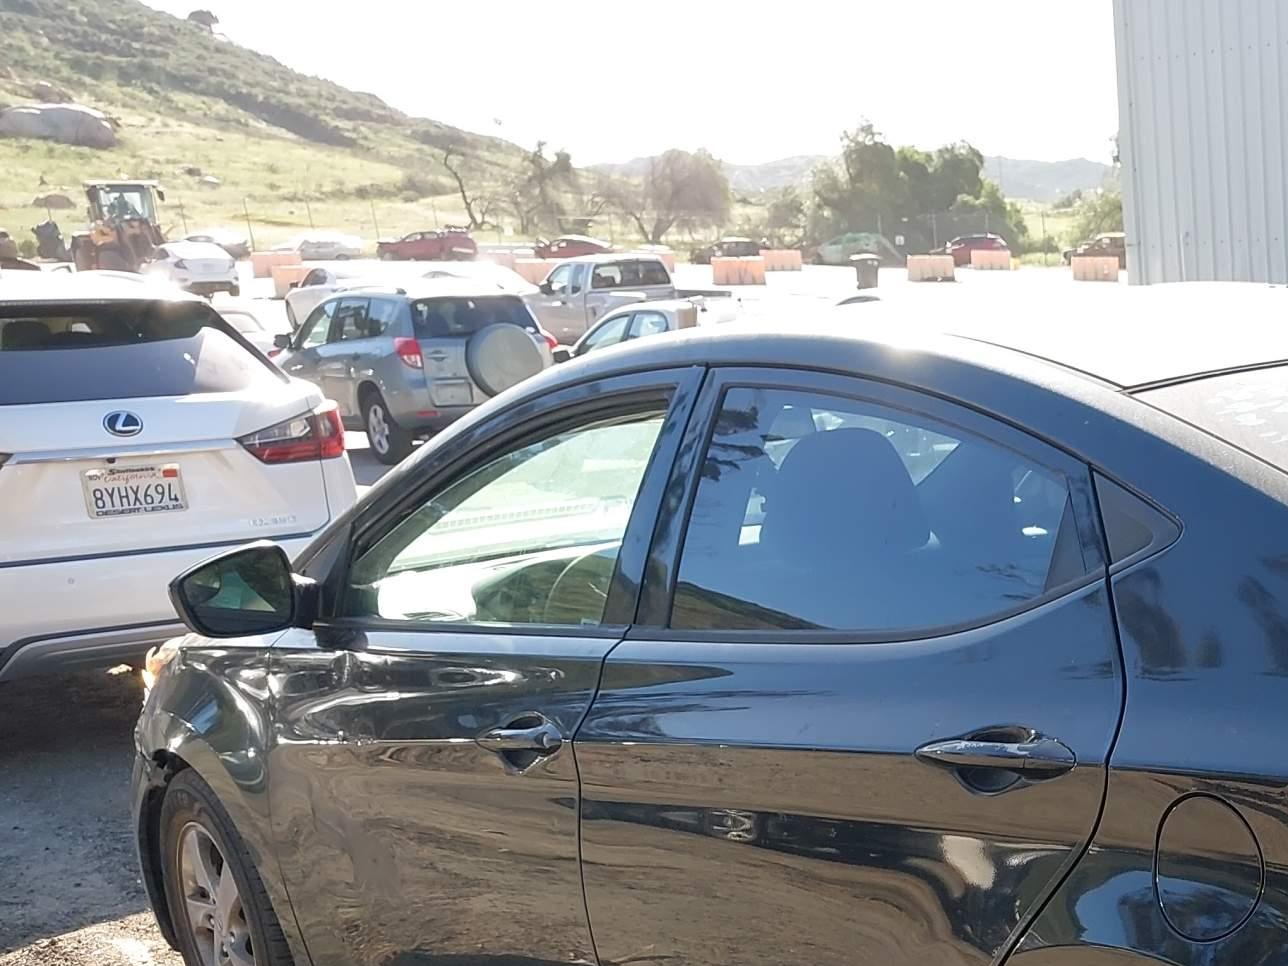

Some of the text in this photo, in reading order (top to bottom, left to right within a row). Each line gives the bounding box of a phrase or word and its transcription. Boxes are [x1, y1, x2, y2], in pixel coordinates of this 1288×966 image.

[93, 483, 179, 509] 8YHX694
[96, 503, 184, 517] DESERT LEXUS
